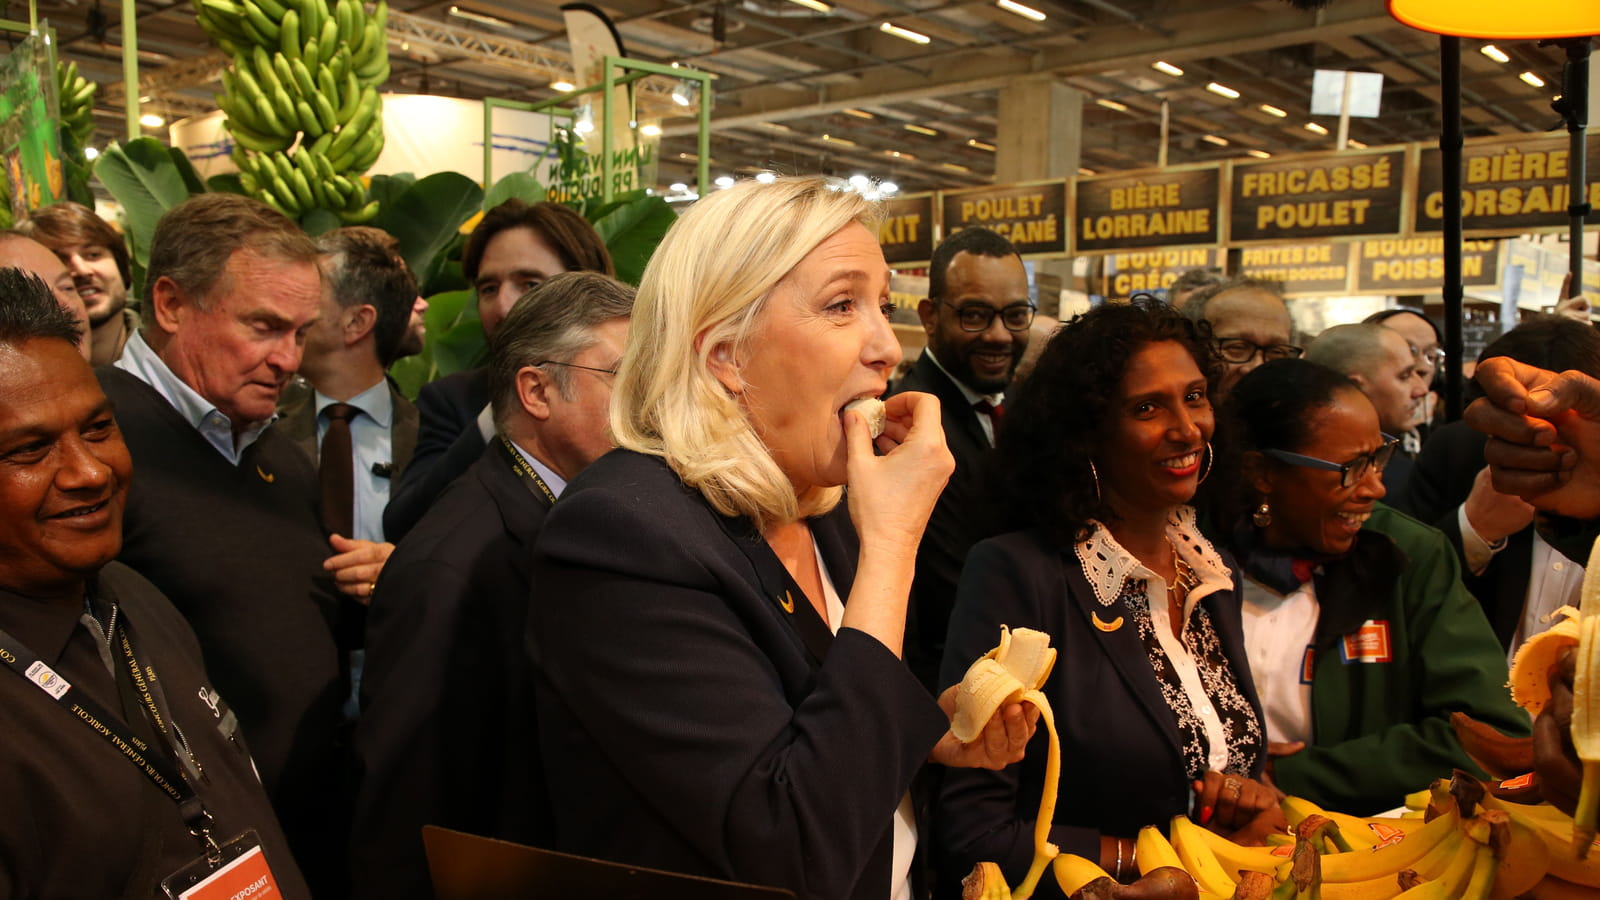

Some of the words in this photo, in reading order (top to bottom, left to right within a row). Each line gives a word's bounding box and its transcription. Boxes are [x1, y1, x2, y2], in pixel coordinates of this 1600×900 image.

[1242, 156, 1391, 197] FRICASSÉ
[1468, 147, 1569, 183] BIÈRE
[962, 194, 1043, 222] POULET
[1110, 181, 1181, 210] BIÈRE
[951, 213, 1057, 244] CANÉ
[1083, 208, 1210, 240] LORRAINE
[1257, 199, 1371, 230] POULET
[1115, 248, 1208, 270] BOUDIN
[1242, 248, 1304, 267] FRITES
[1306, 244, 1332, 263] DE
[1372, 256, 1483, 281] POISSN
[71, 703, 112, 736] AGRICOLE
[111, 733, 146, 767] GÉNÉRAL
[145, 763, 181, 800] CONCOURS
